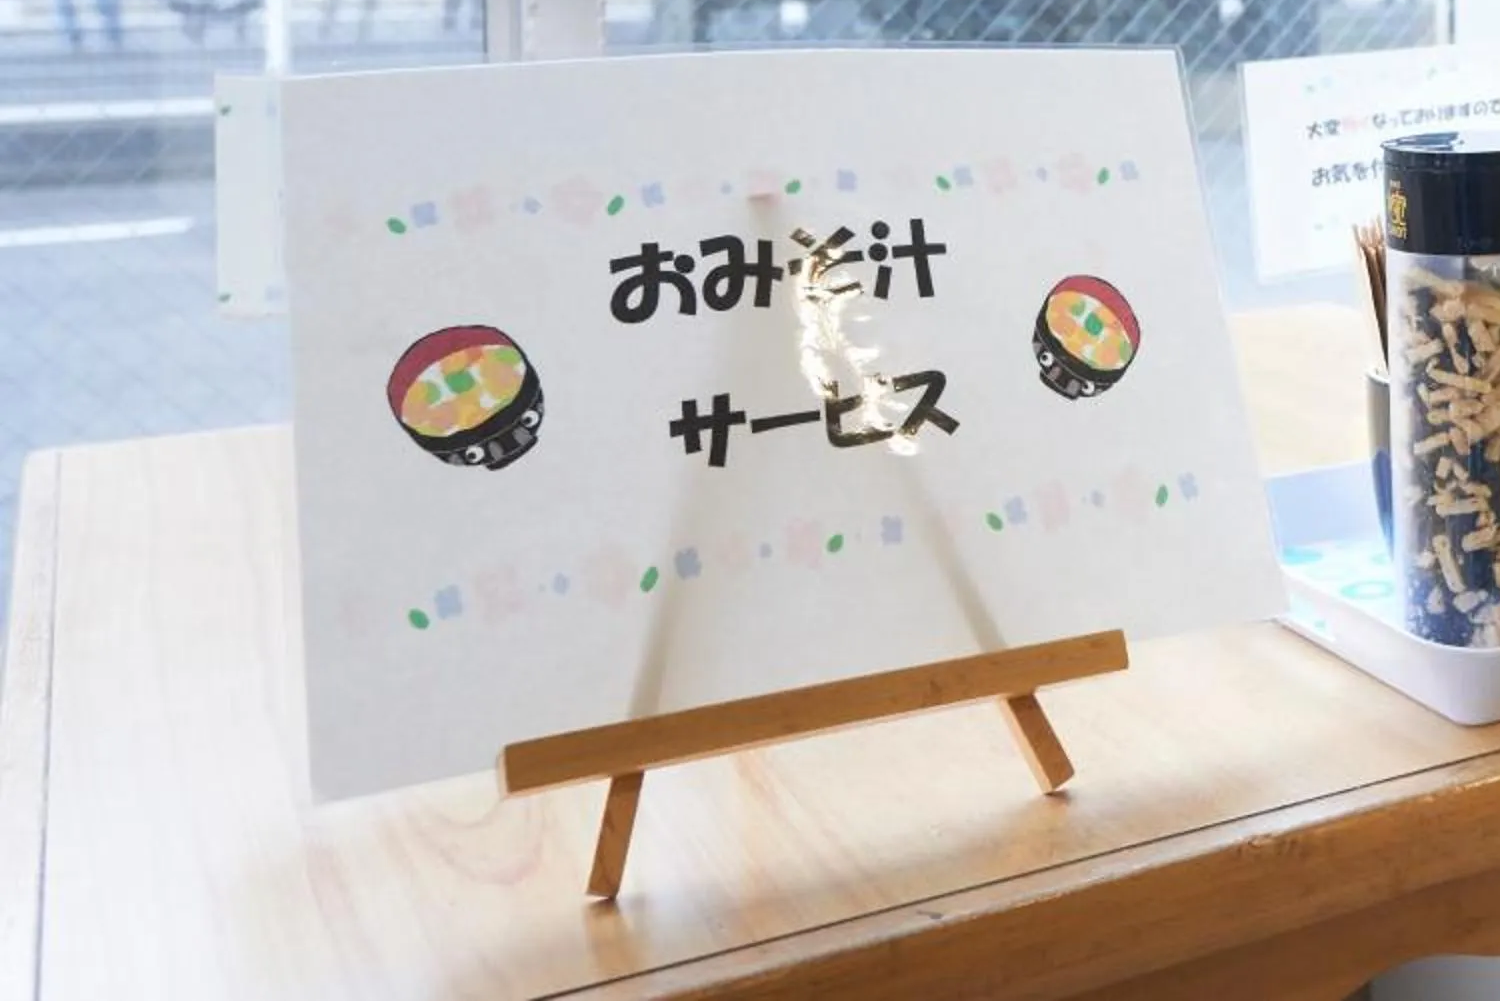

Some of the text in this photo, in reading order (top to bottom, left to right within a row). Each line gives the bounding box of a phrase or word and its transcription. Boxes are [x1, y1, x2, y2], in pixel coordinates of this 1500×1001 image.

[609, 218, 947, 324] おみそ汁
[669, 370, 961, 468] サービス
